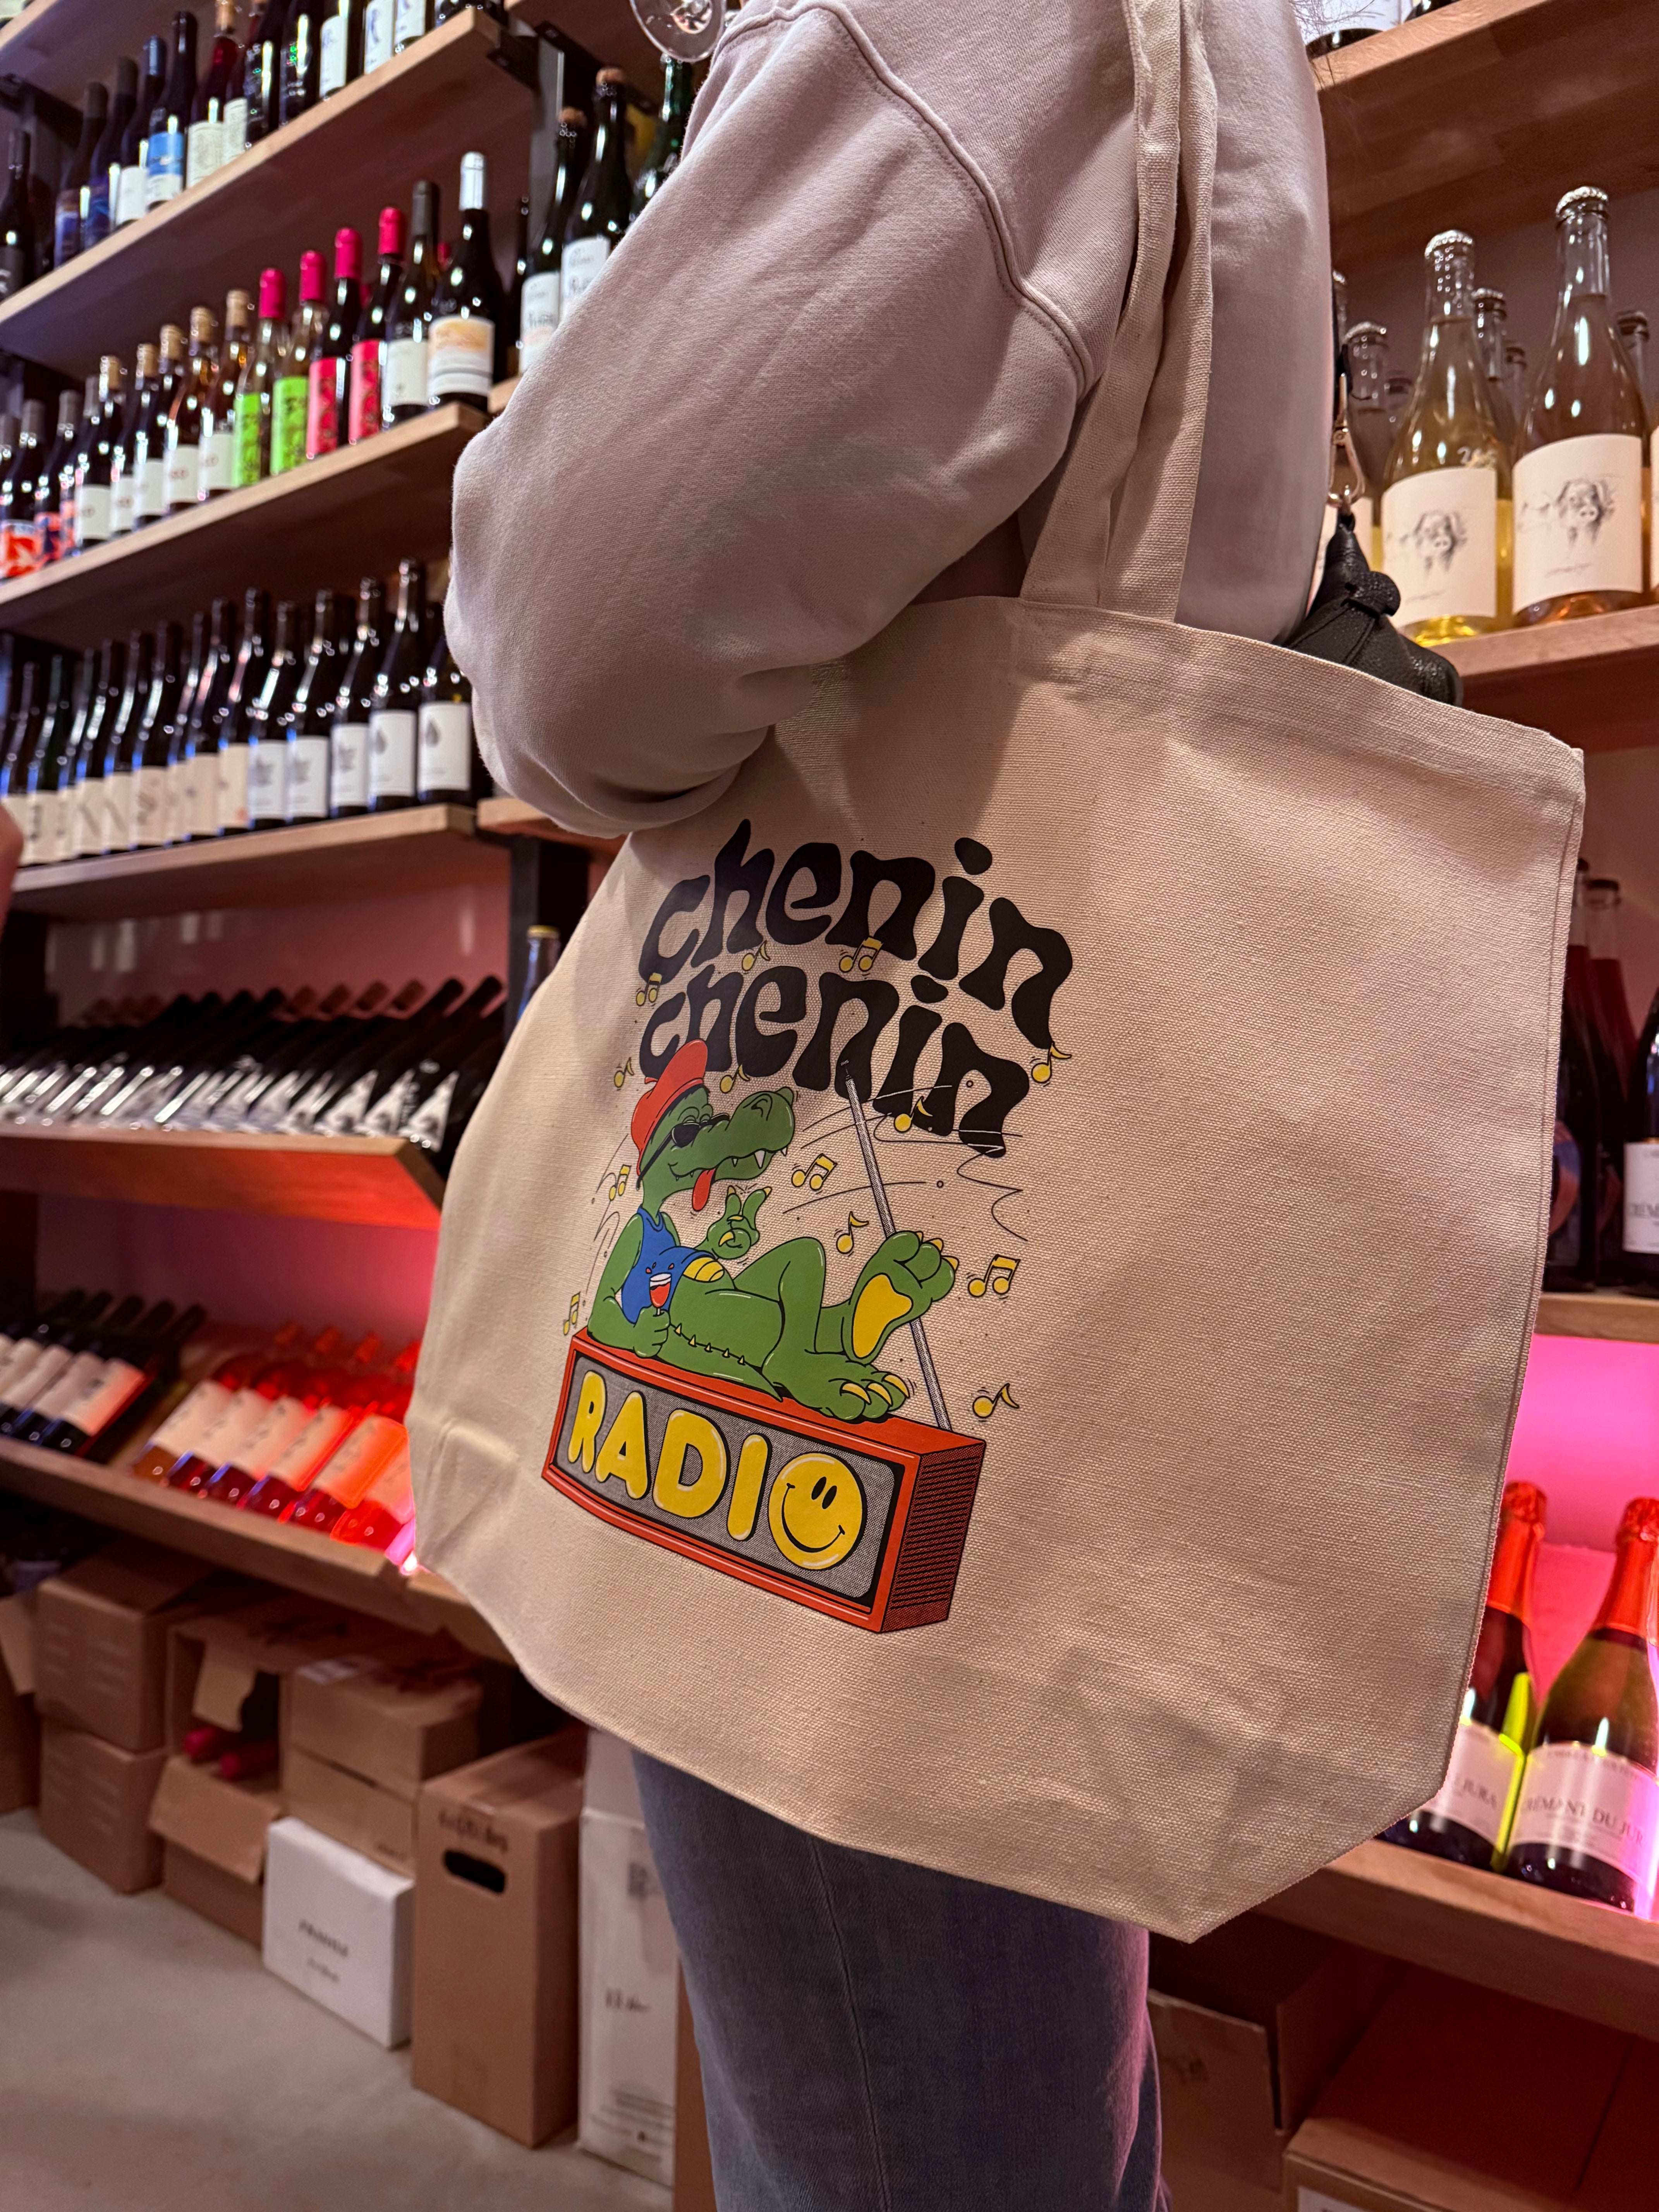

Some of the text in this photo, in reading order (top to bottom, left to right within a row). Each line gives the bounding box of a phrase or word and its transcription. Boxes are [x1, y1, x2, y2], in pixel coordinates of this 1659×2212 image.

[638, 819, 1072, 1048] chenin
[640, 964, 1029, 1157] chenin
[568, 1370, 867, 1570] RADIO
[1593, 1806, 1617, 1828] DU
